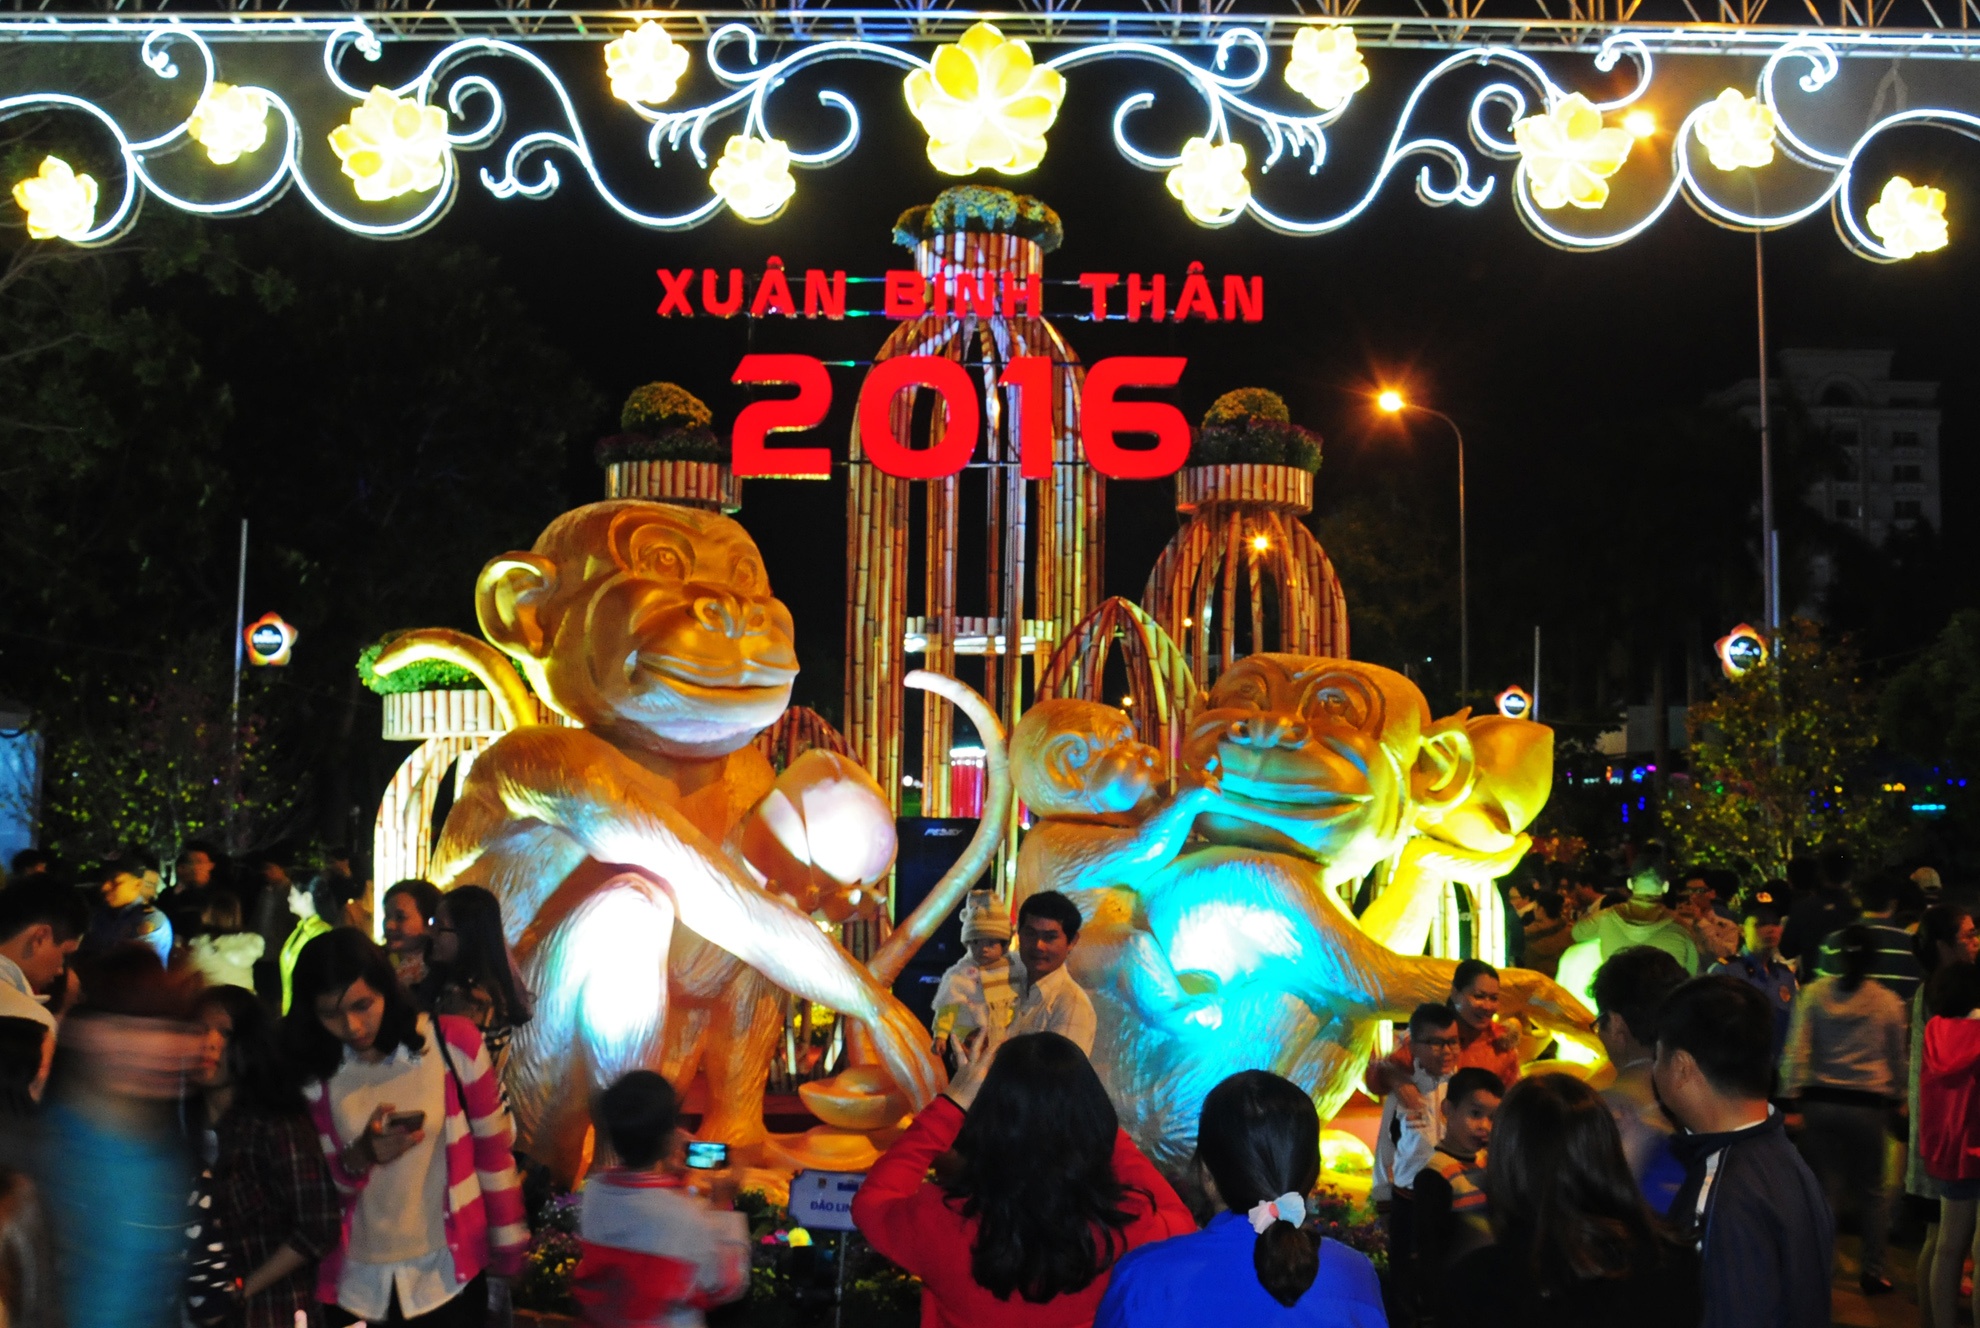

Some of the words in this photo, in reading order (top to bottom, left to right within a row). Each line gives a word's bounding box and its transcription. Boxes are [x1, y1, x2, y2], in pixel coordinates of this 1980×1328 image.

[656, 255, 846, 319] XUÂN
[885, 258, 1041, 319] BÍNH
[1079, 260, 1263, 322] THÂN
[731, 354, 1191, 480] 2016
